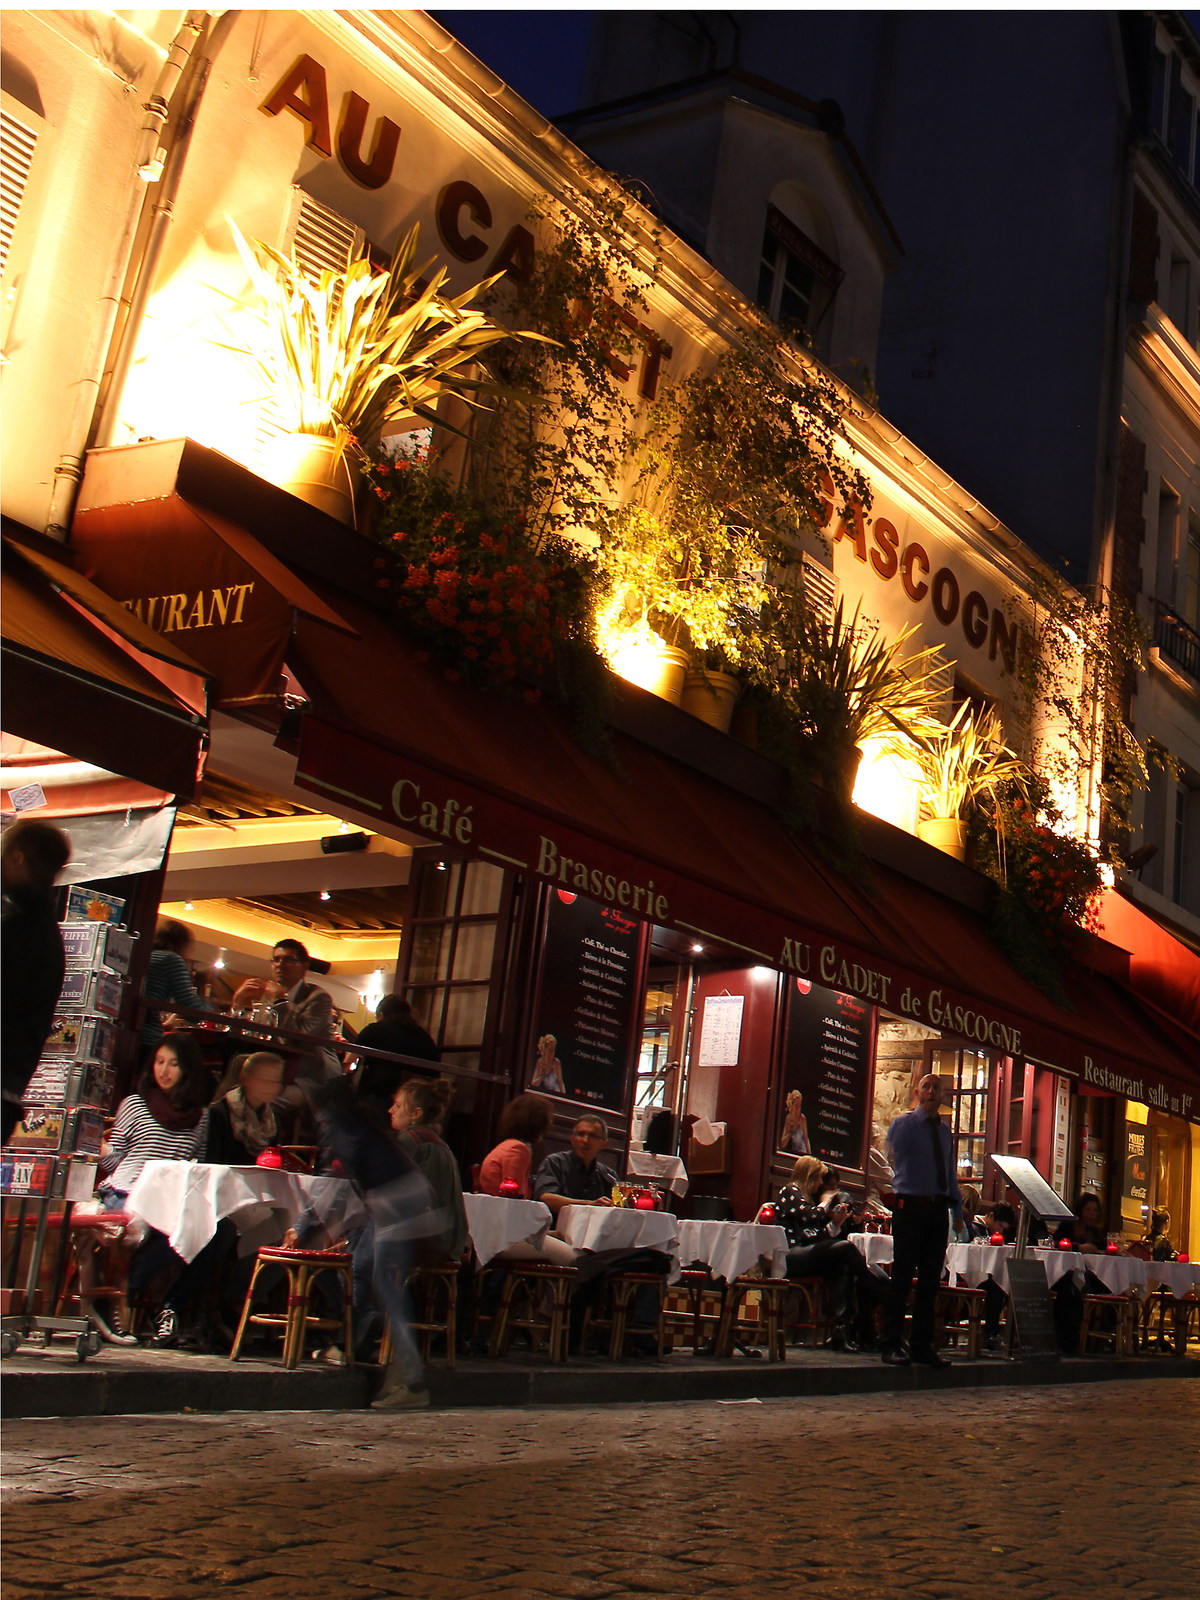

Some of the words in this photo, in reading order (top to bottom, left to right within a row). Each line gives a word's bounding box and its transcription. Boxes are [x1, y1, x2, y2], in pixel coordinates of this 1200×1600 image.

[257, 53, 402, 190] AU
[433, 180, 673, 400] CAET
[806, 468, 1037, 688] GASCOGN
[391, 778, 473, 844] Café
[535, 835, 669, 920] Brasserie
[779, 936, 811, 974] AU
[819, 945, 891, 1004] CADET
[900, 986, 921, 1016] de
[927, 989, 1022, 1055] GASCOGNE
[1084, 1055, 1144, 1100] Restaurant
[1148, 1083, 1169, 1109] salle
